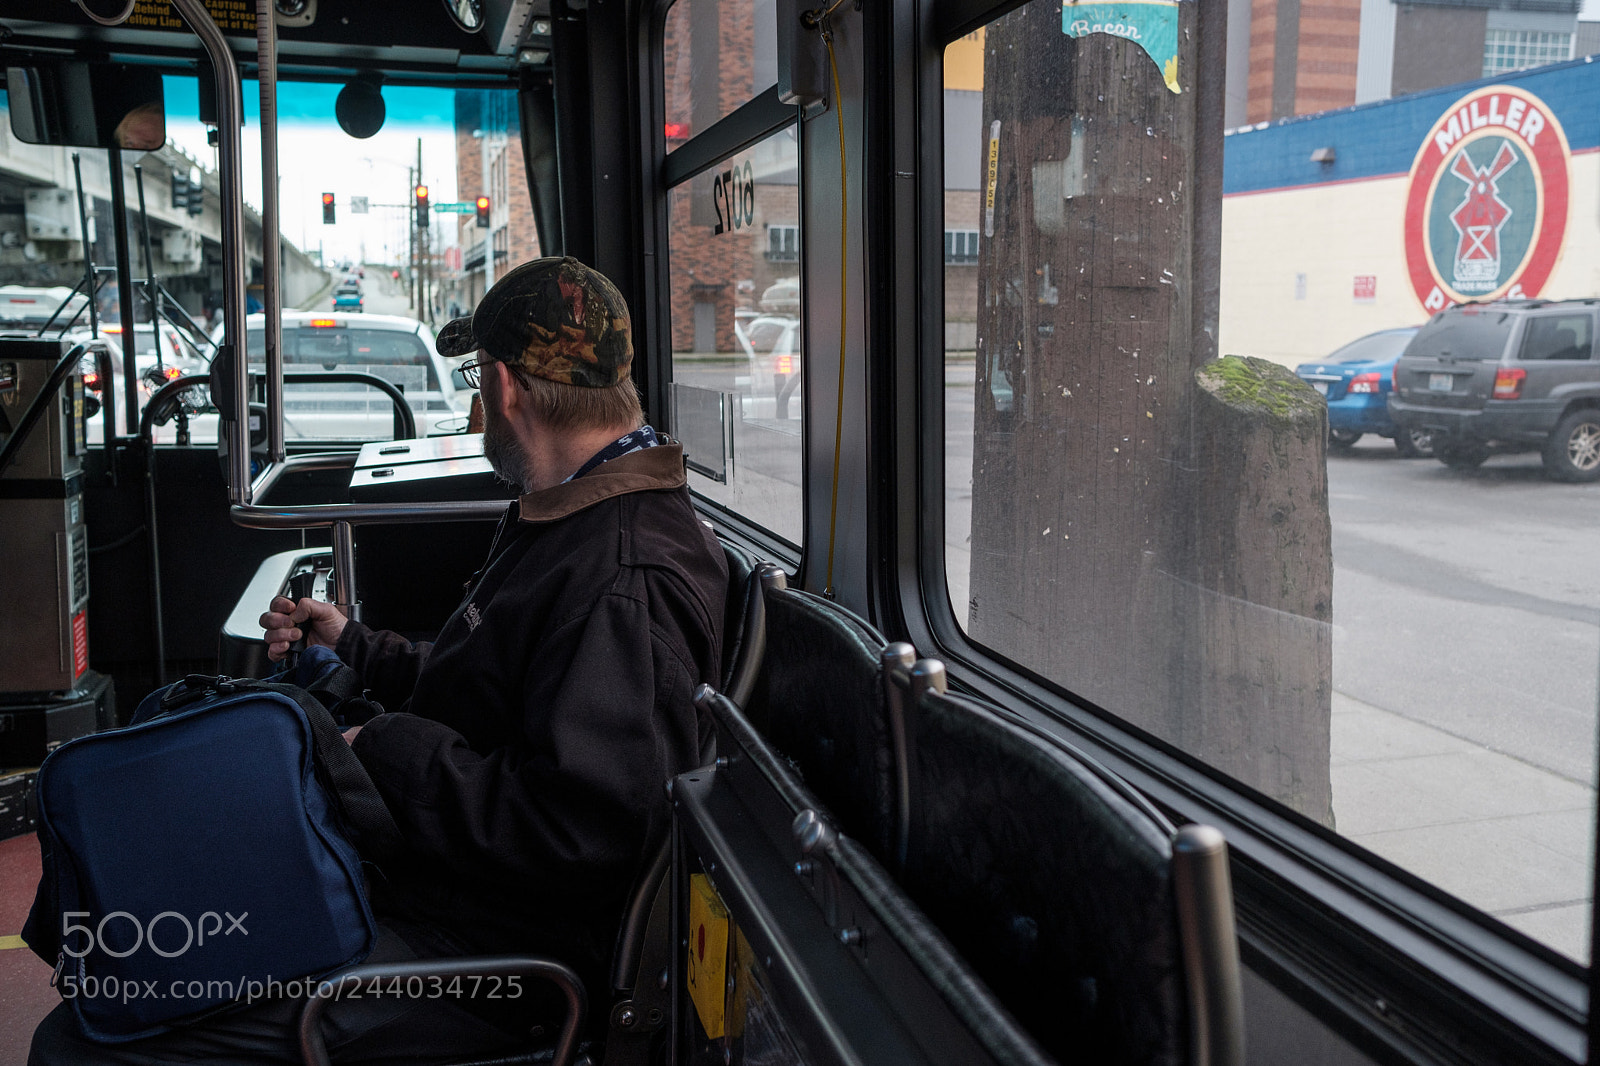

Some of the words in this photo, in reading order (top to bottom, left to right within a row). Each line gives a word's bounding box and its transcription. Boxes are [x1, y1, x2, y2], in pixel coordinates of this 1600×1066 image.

[134, 2, 170, 16] Behind
[204, 0, 247, 11] CAUTION
[125, 14, 158, 25] ellow
[159, 15, 182, 28] Line
[229, 10, 256, 21] Cross
[1070, 19, 1142, 39] Bacon
[1434, 95, 1545, 155] MILLER
[987, 140, 998, 208] 1369052
